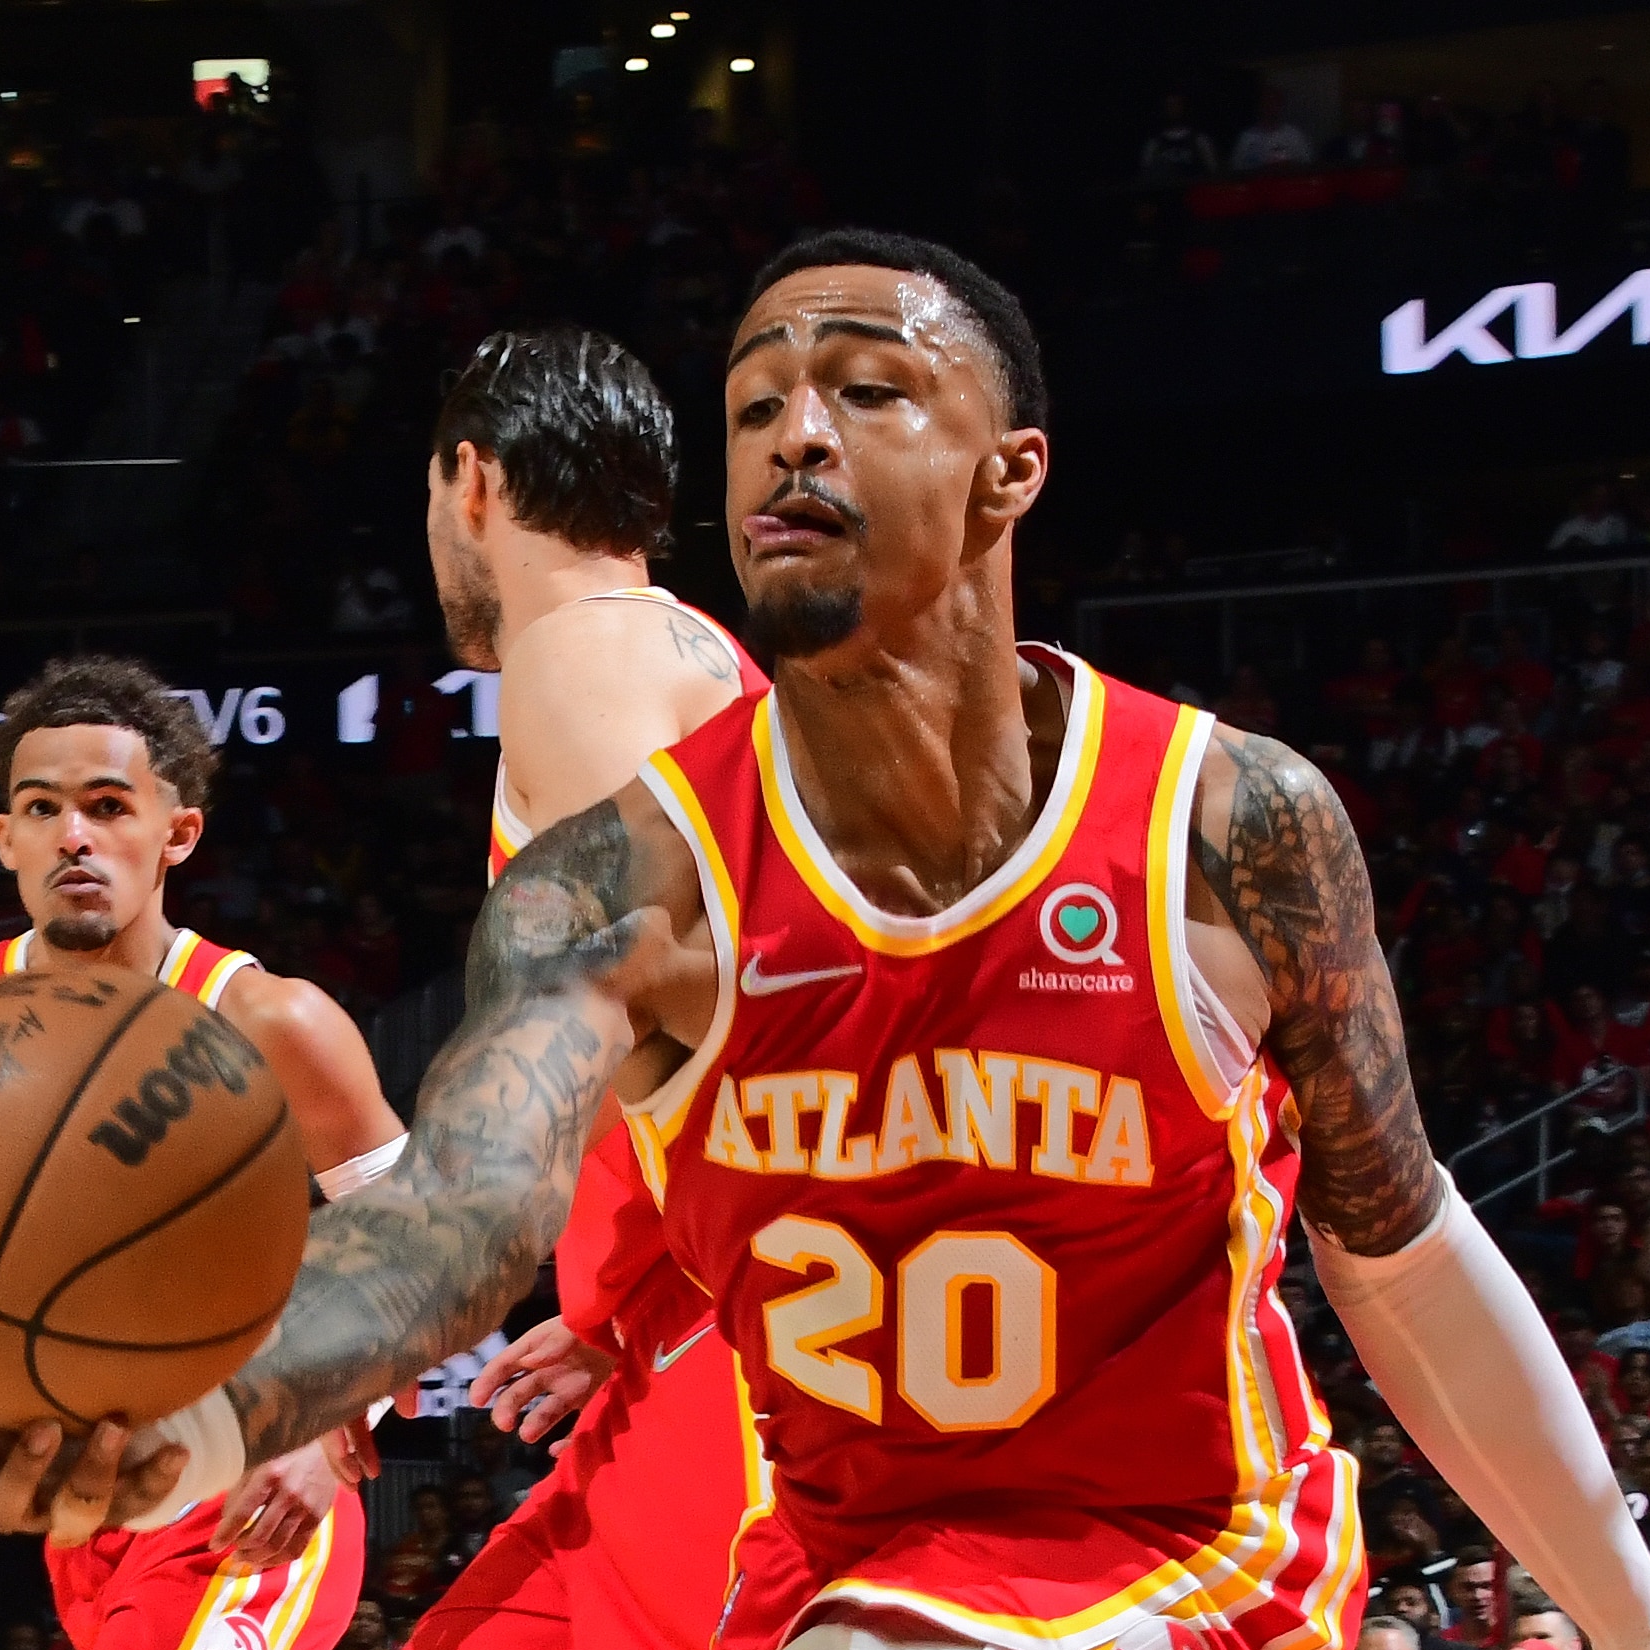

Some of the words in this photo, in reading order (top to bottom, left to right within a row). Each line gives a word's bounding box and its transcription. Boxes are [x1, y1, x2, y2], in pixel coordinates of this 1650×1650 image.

[165, 685, 286, 745] V6
[1017, 969, 1134, 992] sharecare
[704, 1048, 1155, 1188] ATLANTA
[751, 1213, 1057, 1433] 20
